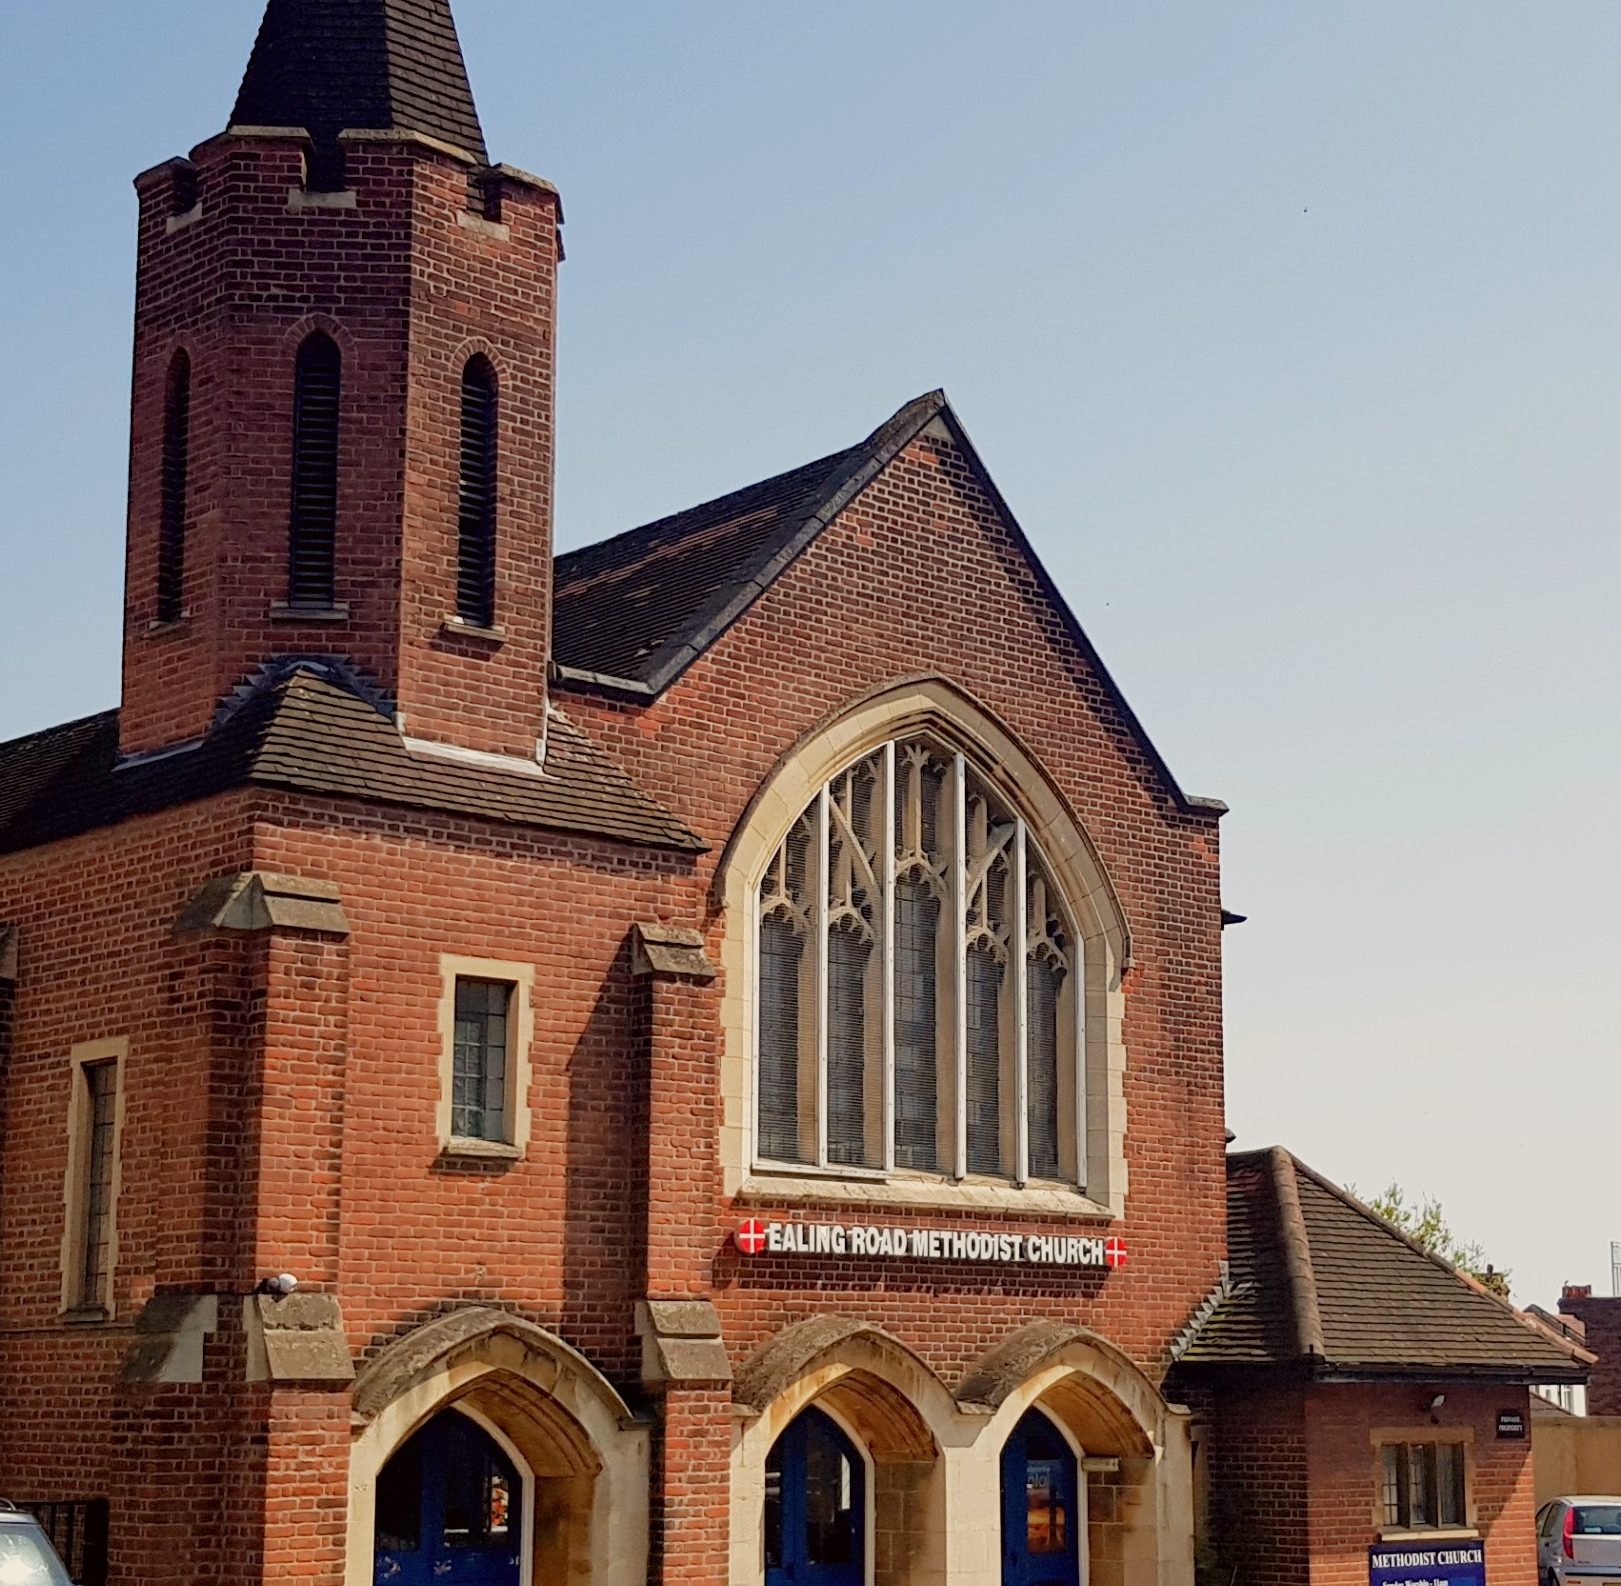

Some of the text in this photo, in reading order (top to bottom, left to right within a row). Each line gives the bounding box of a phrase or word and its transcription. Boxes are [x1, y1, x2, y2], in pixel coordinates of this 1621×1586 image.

[768, 1222, 1104, 1266] EALING ROAD METHODIST CHURCH
[1372, 1549, 1483, 1569] METHODIST CHURCH
